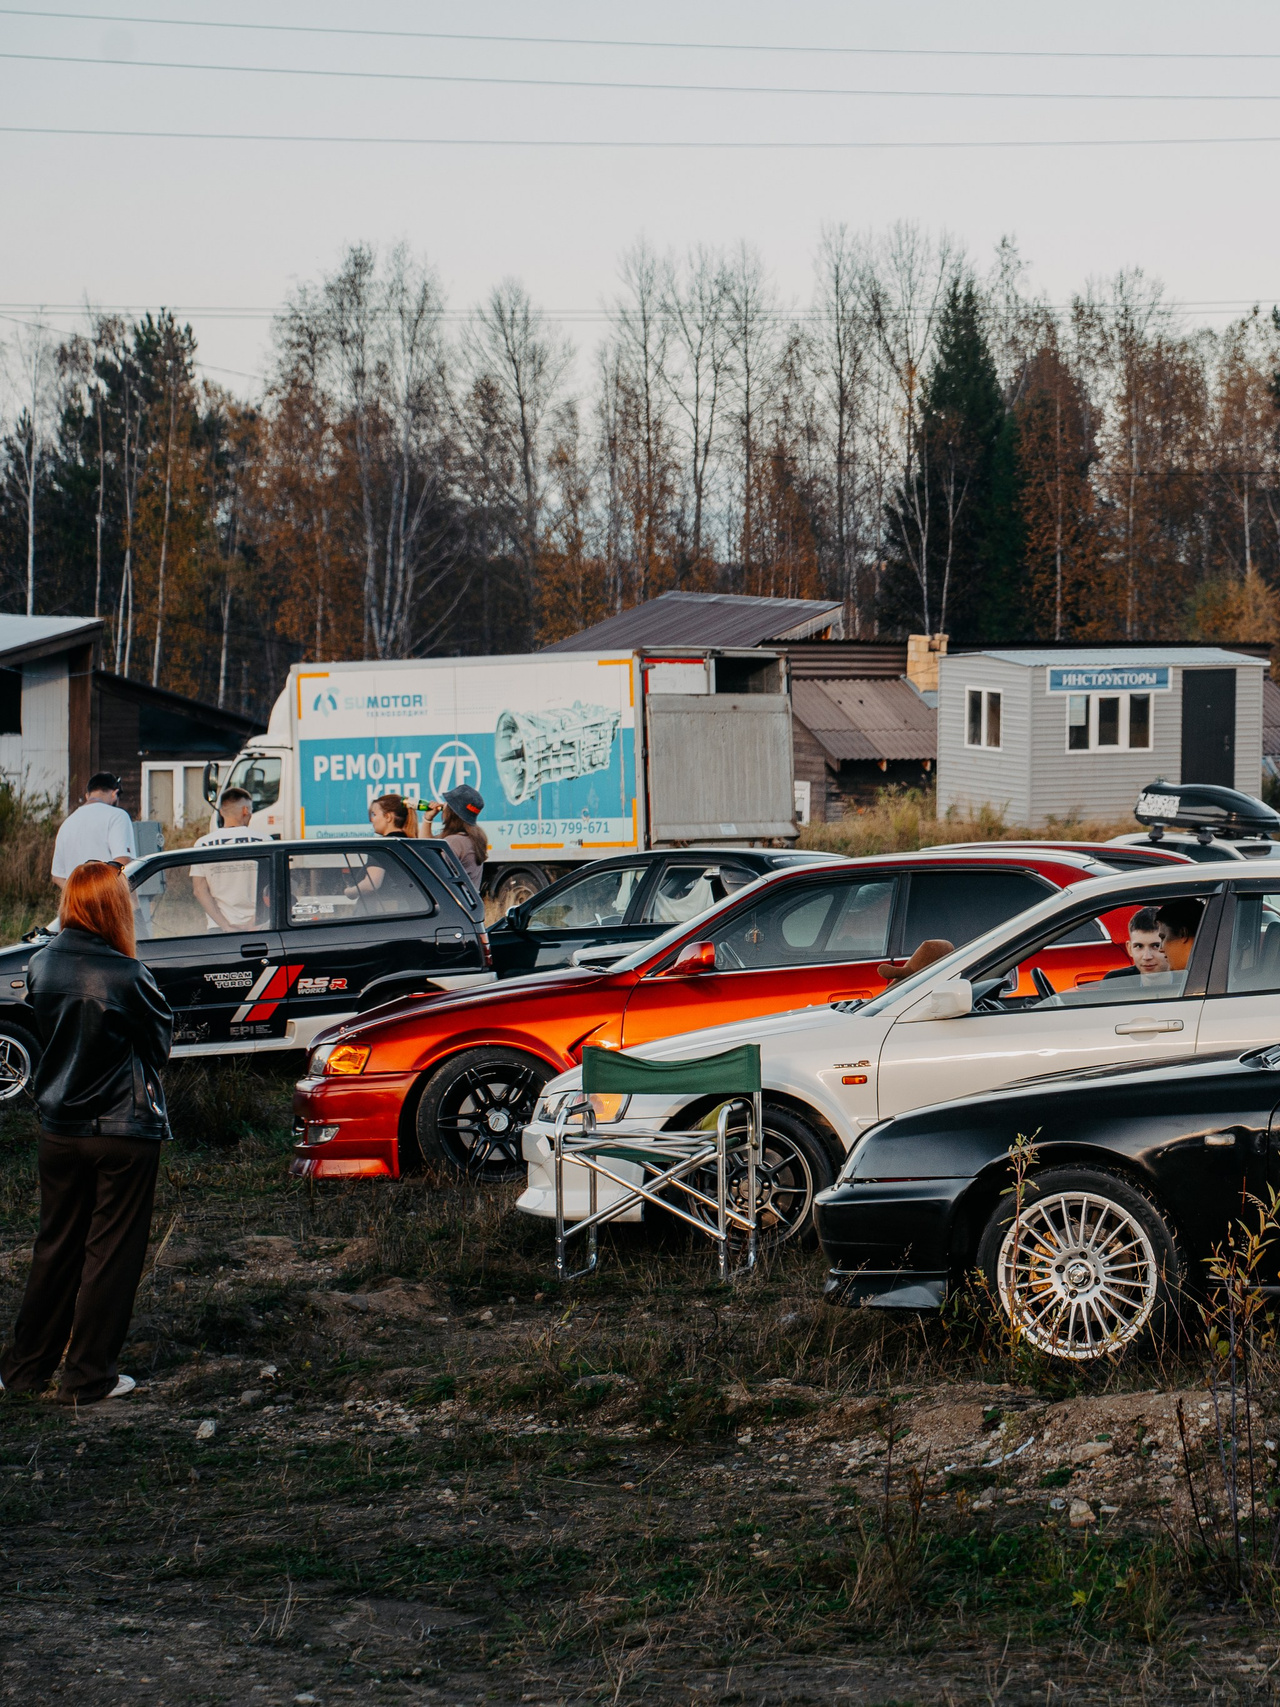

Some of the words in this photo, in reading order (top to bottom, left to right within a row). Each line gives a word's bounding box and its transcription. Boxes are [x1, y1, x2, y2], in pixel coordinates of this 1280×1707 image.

[1061, 672, 1157, 686] ИНСТРУКТОРЫ
[313, 752, 421, 782] РЕМОНТ
[498, 823, 514, 836] +7
[561, 821, 610, 834] 799-671
[203, 972, 229, 982] TWIN
[230, 971, 253, 980] CAM
[214, 979, 253, 989] TURBO
[298, 987, 327, 995] WORKS
